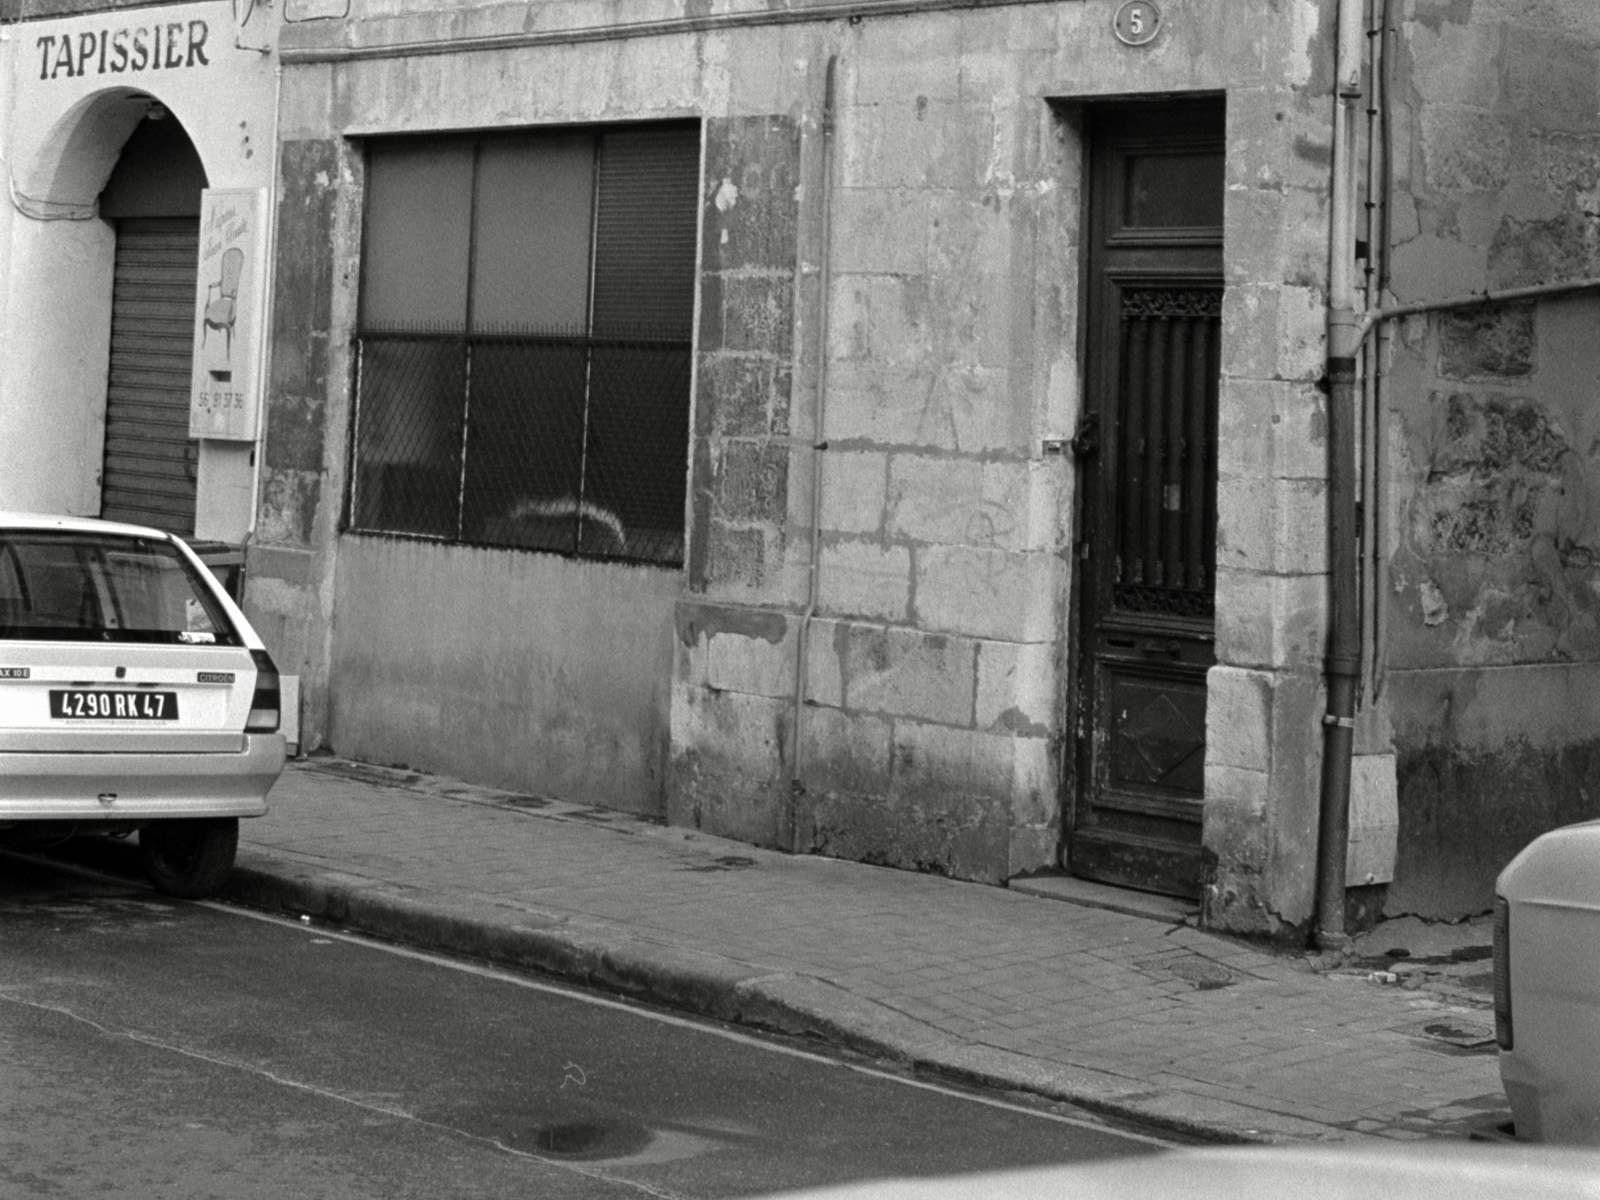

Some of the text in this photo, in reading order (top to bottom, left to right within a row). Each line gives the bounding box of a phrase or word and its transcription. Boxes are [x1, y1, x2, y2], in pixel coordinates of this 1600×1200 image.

[1130, 8, 1143, 34] 5
[37, 19, 210, 81] TAPISSIER
[62, 692, 165, 717] 4290 RK 47
